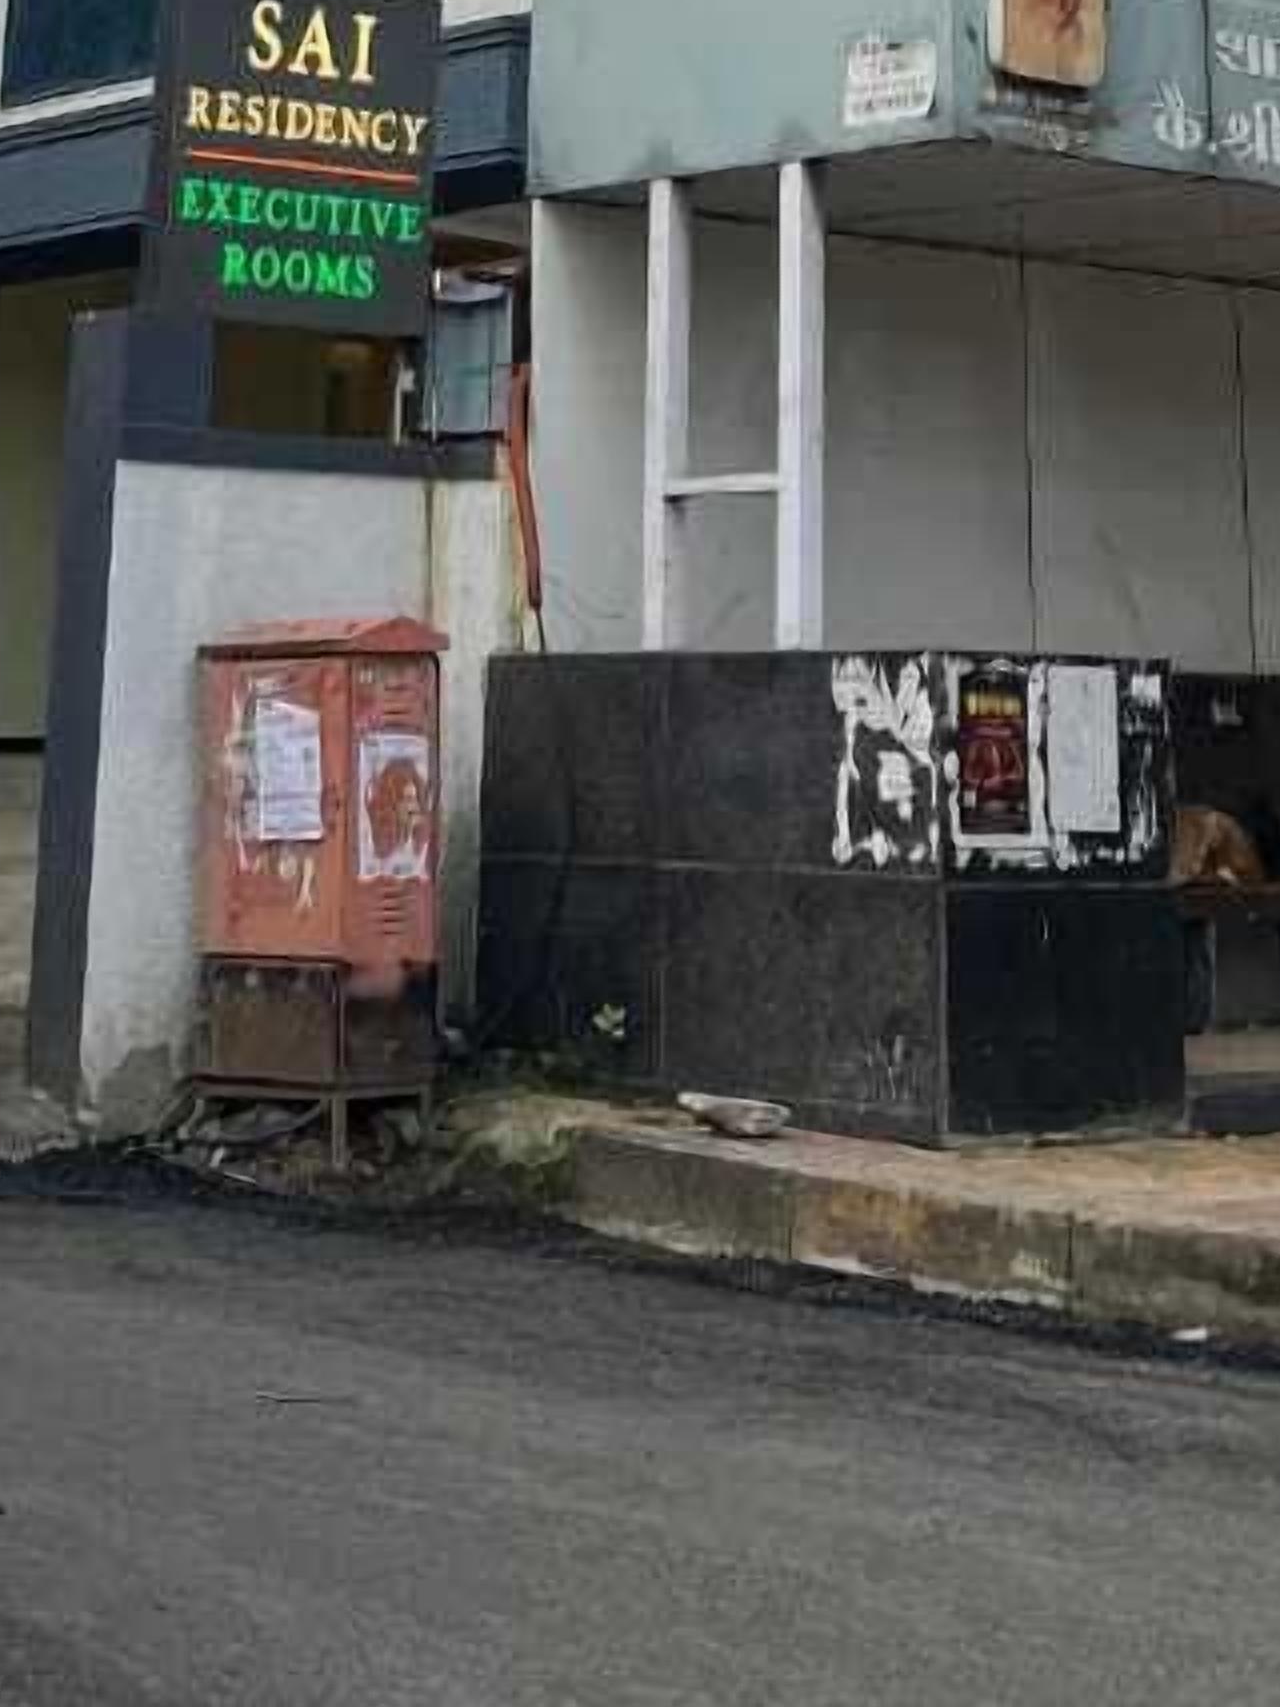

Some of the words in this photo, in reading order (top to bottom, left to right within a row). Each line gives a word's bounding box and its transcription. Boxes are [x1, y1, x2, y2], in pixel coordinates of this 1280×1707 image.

[186, 85, 428, 156] RESIDENCY
[180, 177, 423, 243] EXECUTIVE
[221, 240, 375, 300] ROOMS
